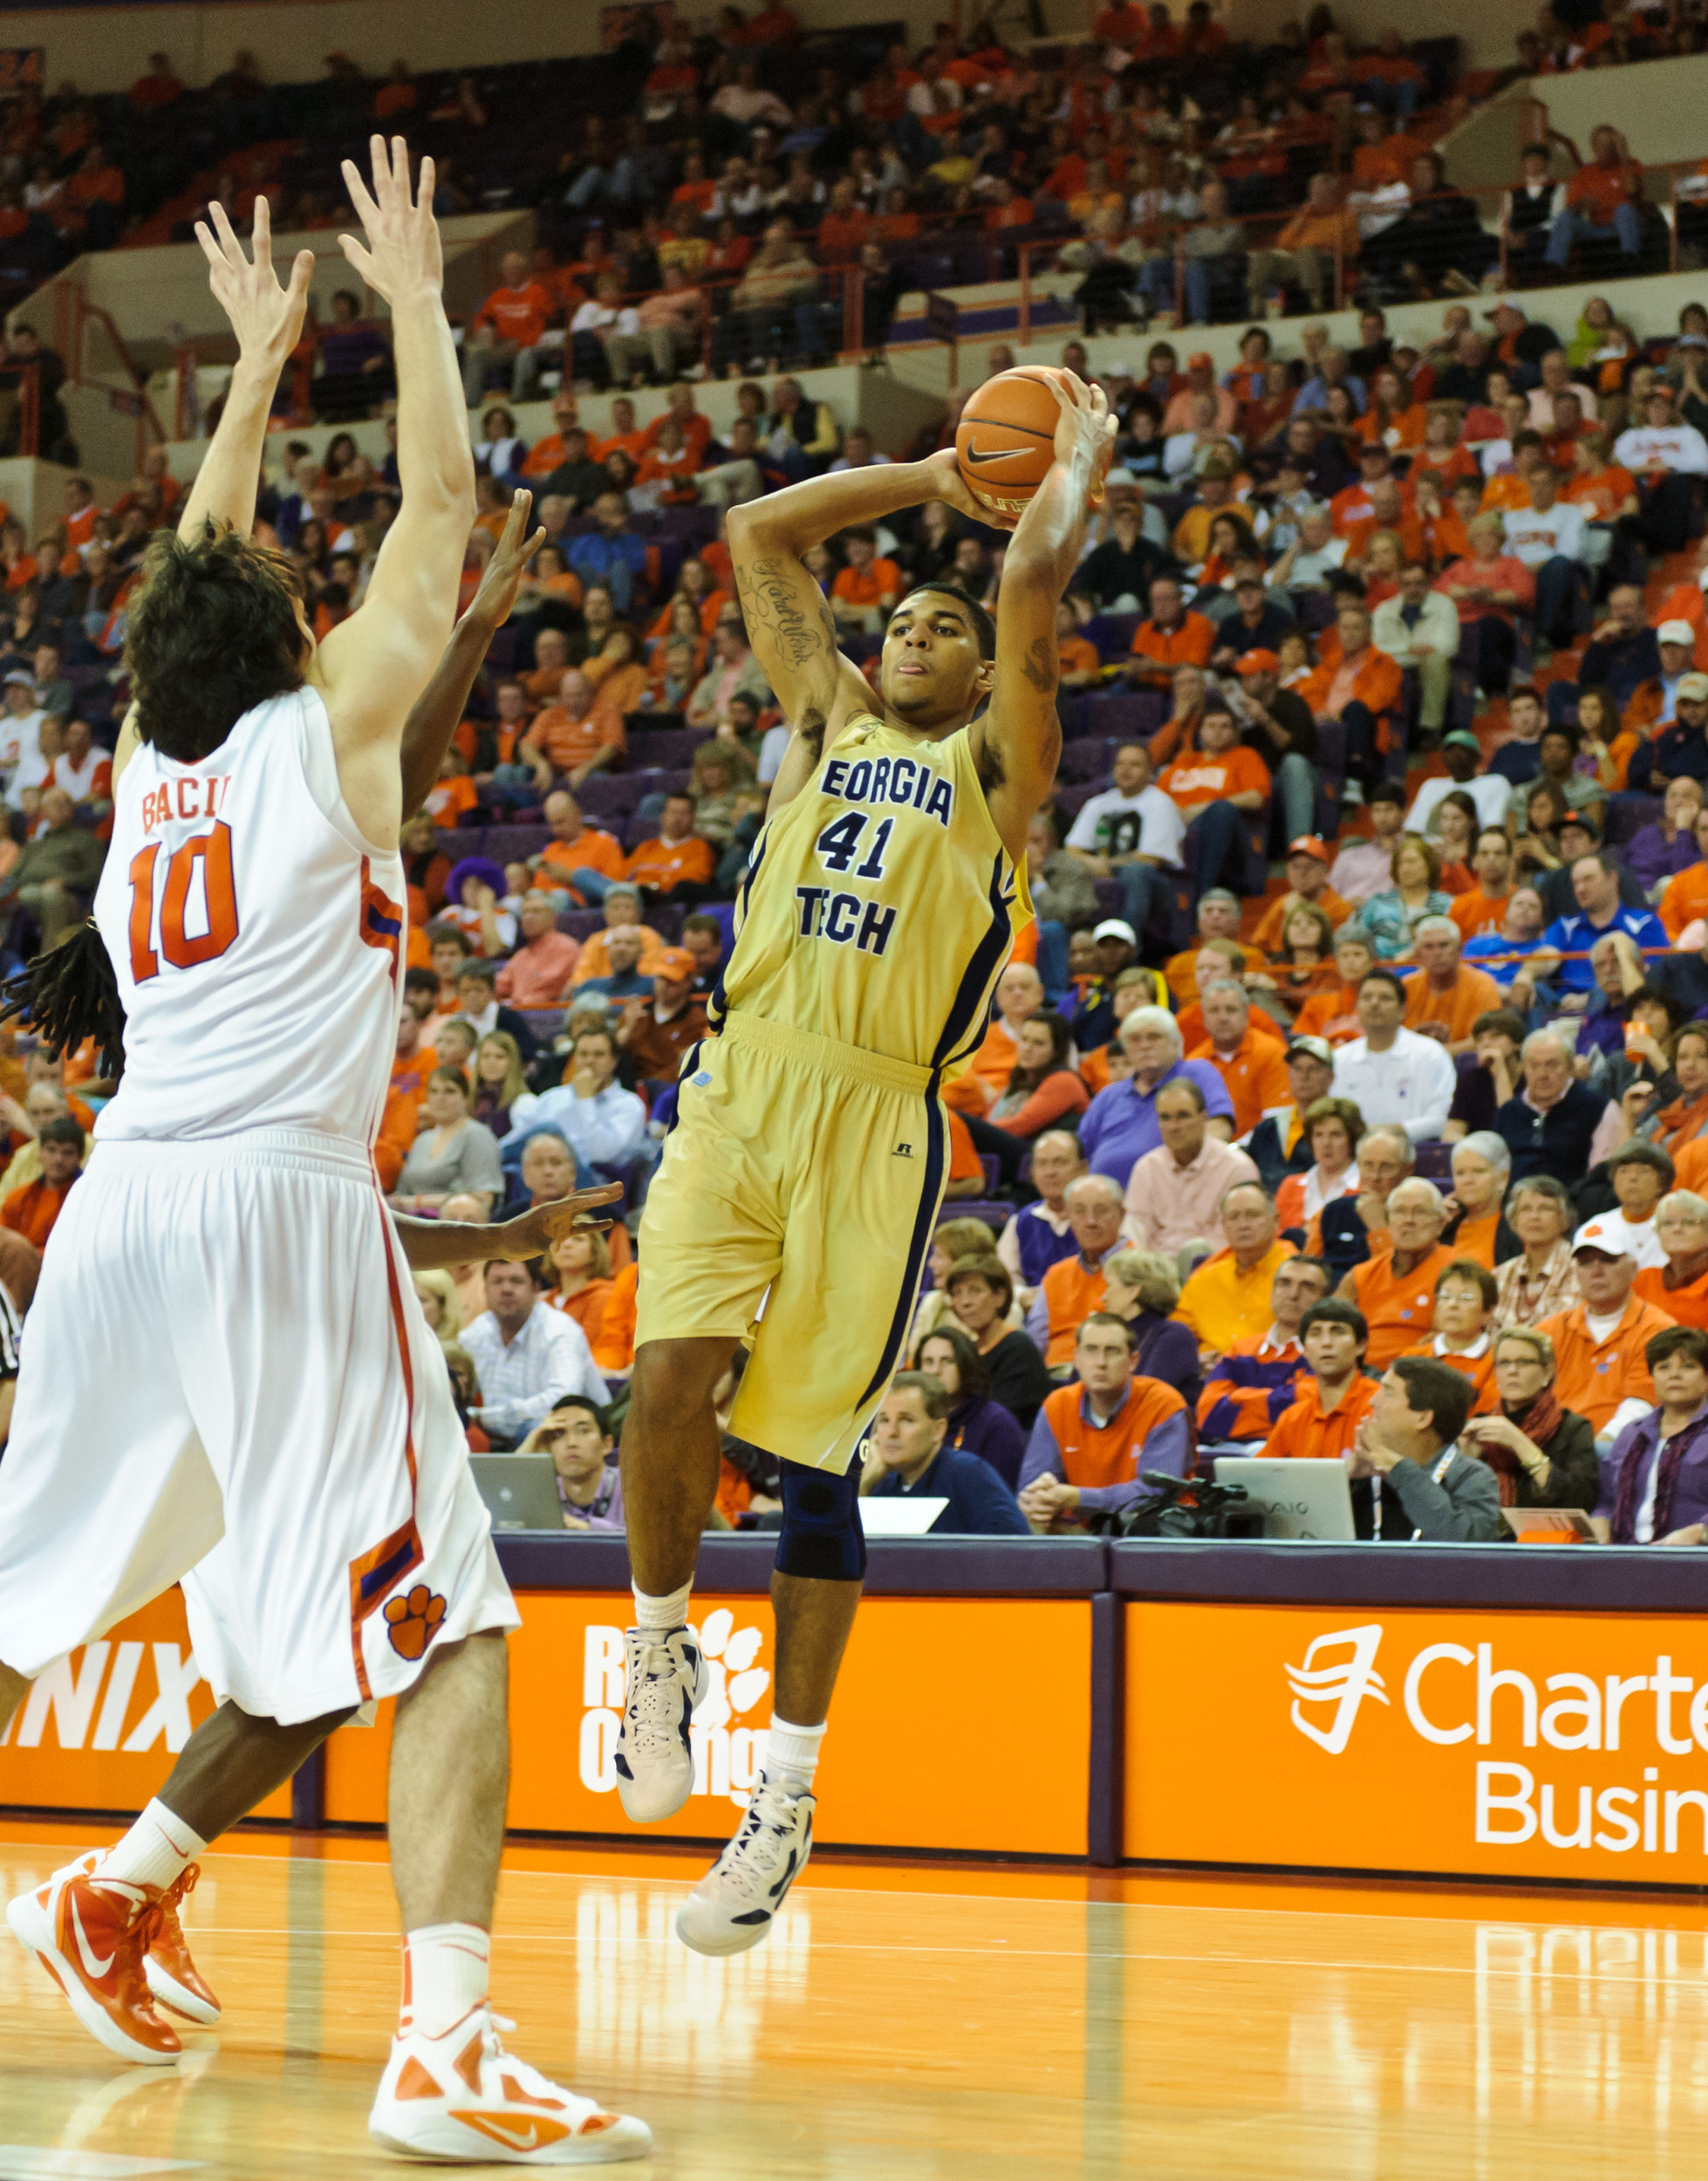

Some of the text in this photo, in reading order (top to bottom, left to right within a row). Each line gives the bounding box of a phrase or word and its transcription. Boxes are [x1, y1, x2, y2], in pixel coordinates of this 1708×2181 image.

[142, 775, 231, 835] BACI
[815, 808, 896, 881] 41
[128, 818, 240, 986] 10
[0, 1640, 202, 1754] NIX
